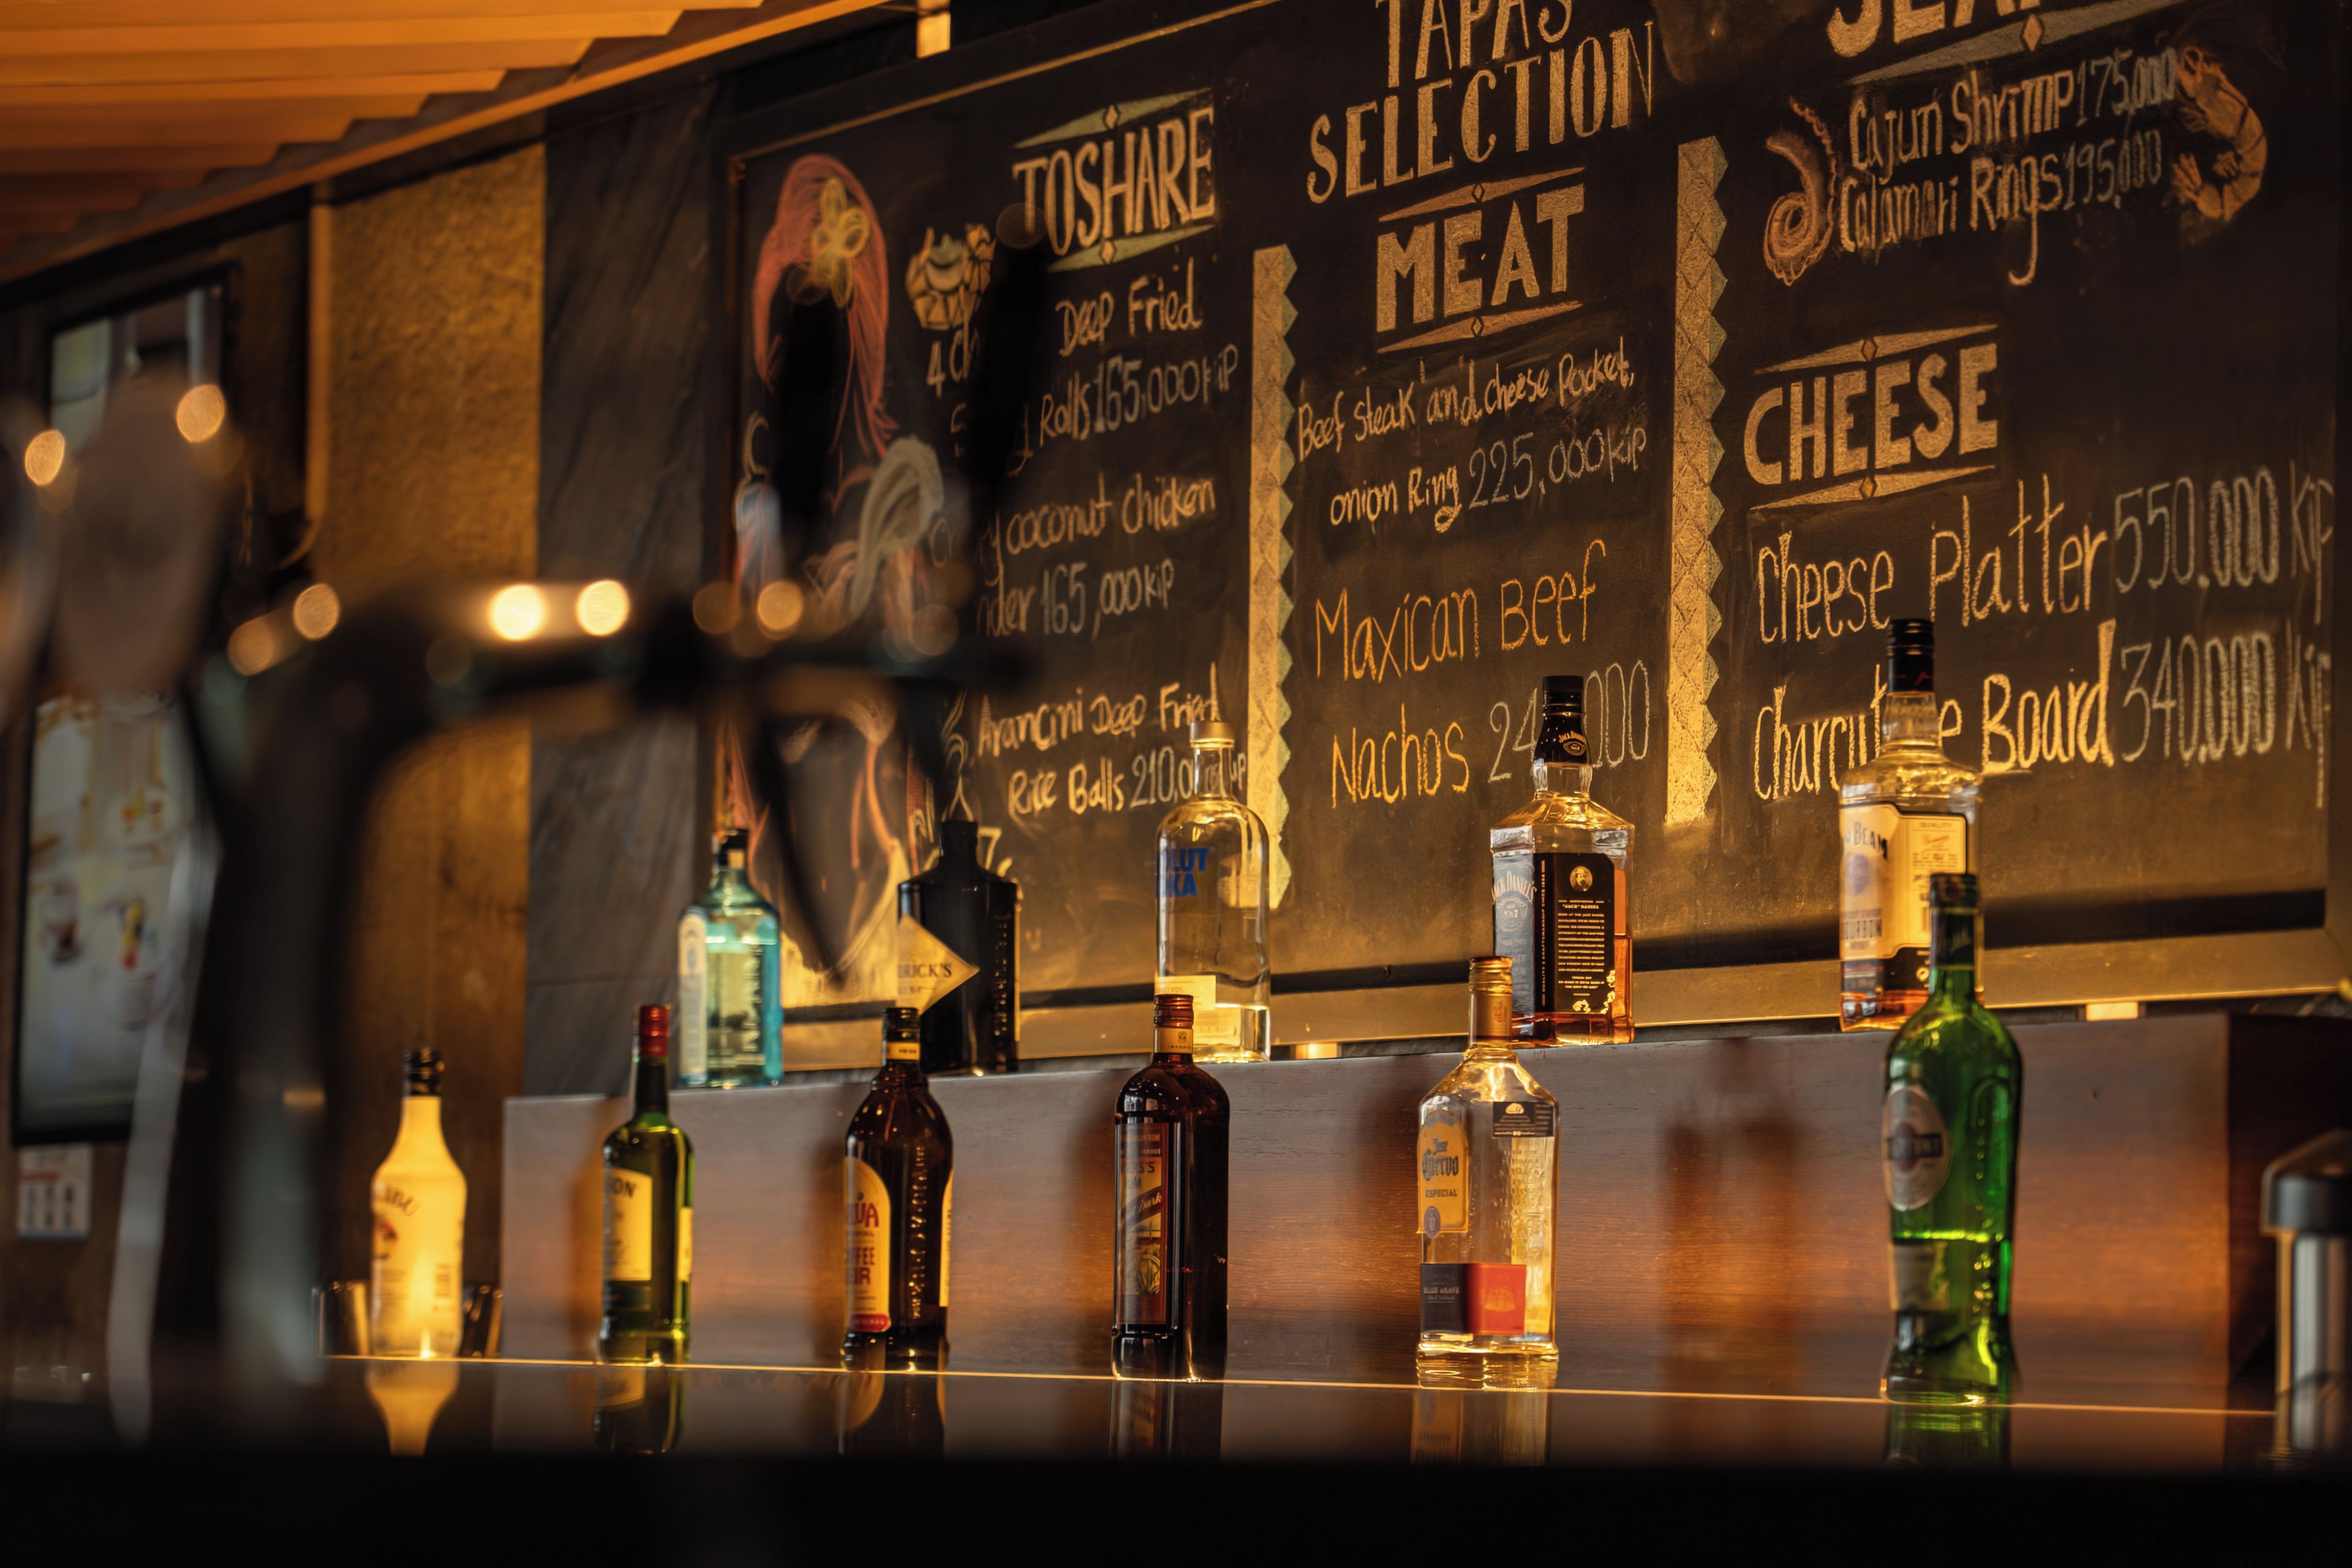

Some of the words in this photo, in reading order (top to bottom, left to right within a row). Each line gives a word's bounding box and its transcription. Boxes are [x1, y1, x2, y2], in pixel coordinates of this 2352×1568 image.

[1307, 20, 1653, 203] SELECTION
[1849, 98, 1943, 185] Cajun
[1377, 183, 1585, 333] MEAT
[1969, 154, 2064, 285] Rings
[1128, 256, 1203, 336] Fried
[1040, 370, 1091, 448] Rolls
[1298, 391, 1346, 462] Beef
[1427, 359, 1483, 426] and
[1743, 342, 1998, 485] CHEESE
[1330, 480, 1398, 527] onion
[1409, 466, 1462, 533] Ring
[1929, 472, 2108, 627] Platter
[1316, 587, 1479, 684] Maxican
[1502, 539, 1606, 650] Beef
[1981, 619, 2115, 773] Board
[1068, 756, 1125, 815] Balls
[1332, 703, 1469, 809] Nachos
[1425, 1189, 1458, 1198] ESPECIAL
